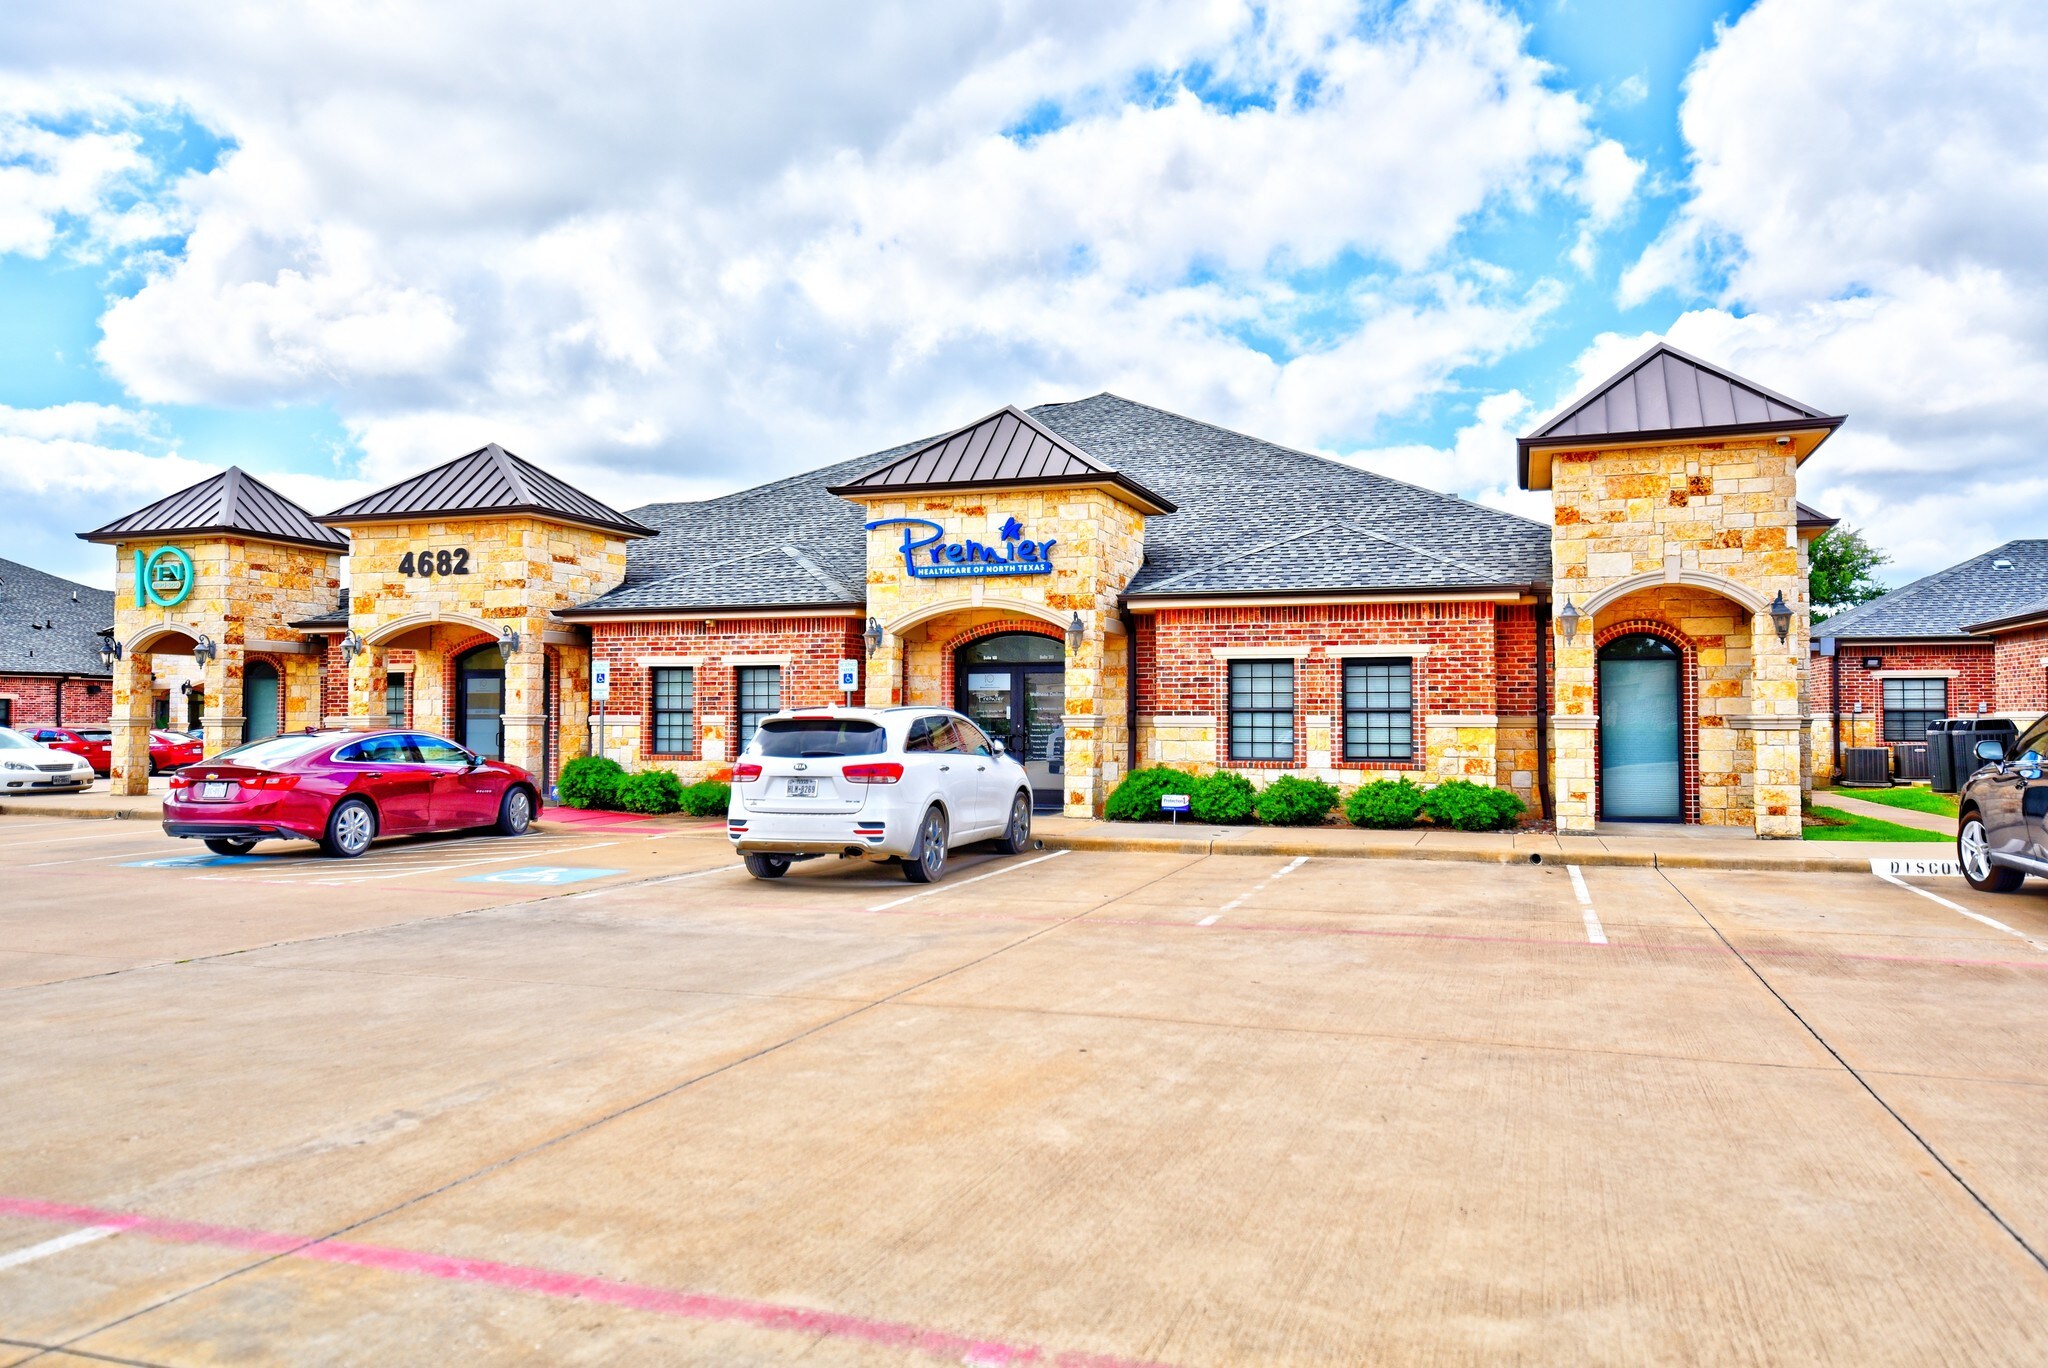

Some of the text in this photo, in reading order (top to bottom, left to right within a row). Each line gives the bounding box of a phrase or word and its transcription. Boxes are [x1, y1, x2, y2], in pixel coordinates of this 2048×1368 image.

[864, 517, 1057, 577] Premier
[154, 564, 184, 581] TEN
[398, 547, 470, 577] 4682
[918, 563, 1045, 576] HEALTHCARE OF NORTH TEXAS
